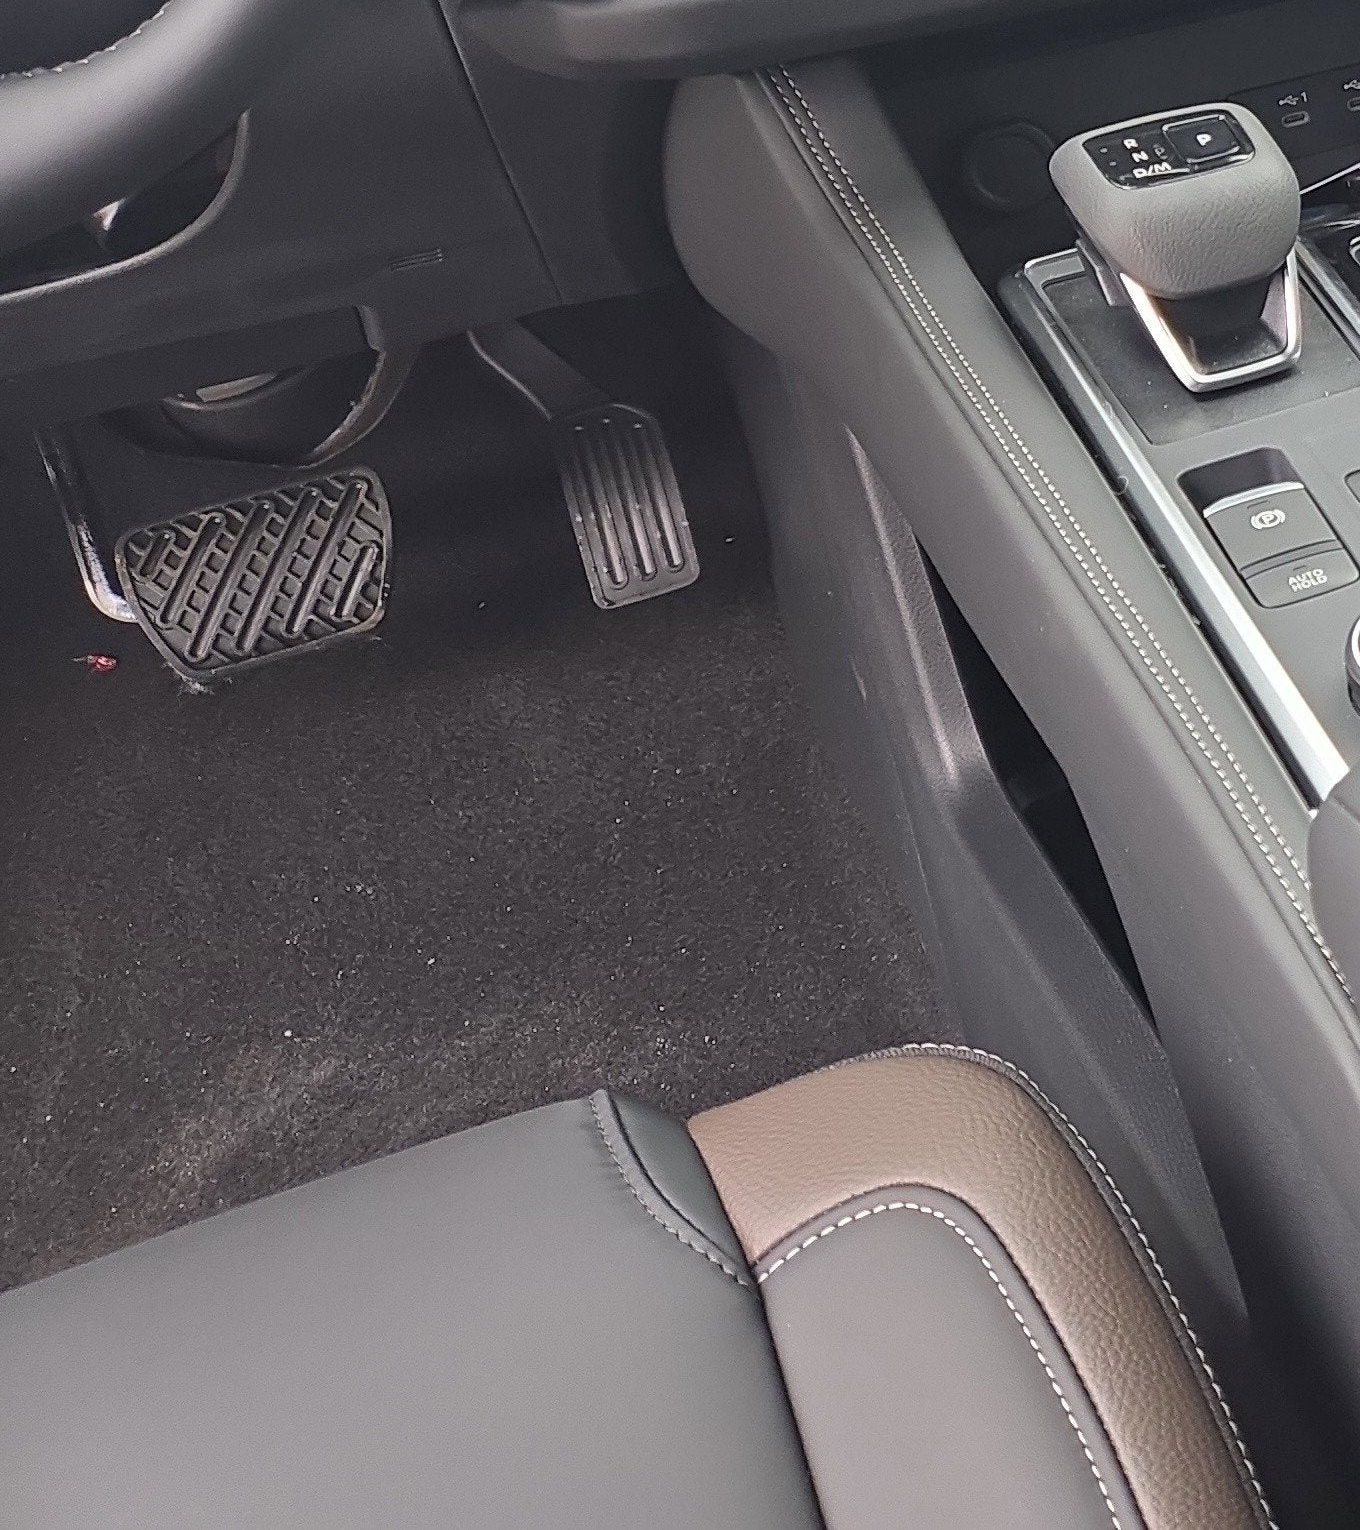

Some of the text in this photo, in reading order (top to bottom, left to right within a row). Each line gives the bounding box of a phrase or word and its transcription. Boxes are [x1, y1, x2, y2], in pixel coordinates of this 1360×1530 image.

[1123, 139, 1139, 151] R
[1196, 133, 1212, 146] P
[1131, 151, 1149, 162] N
[1132, 162, 1172, 178] D/M
[1288, 568, 1324, 585] AUTO
[1290, 574, 1328, 592] HOLD
